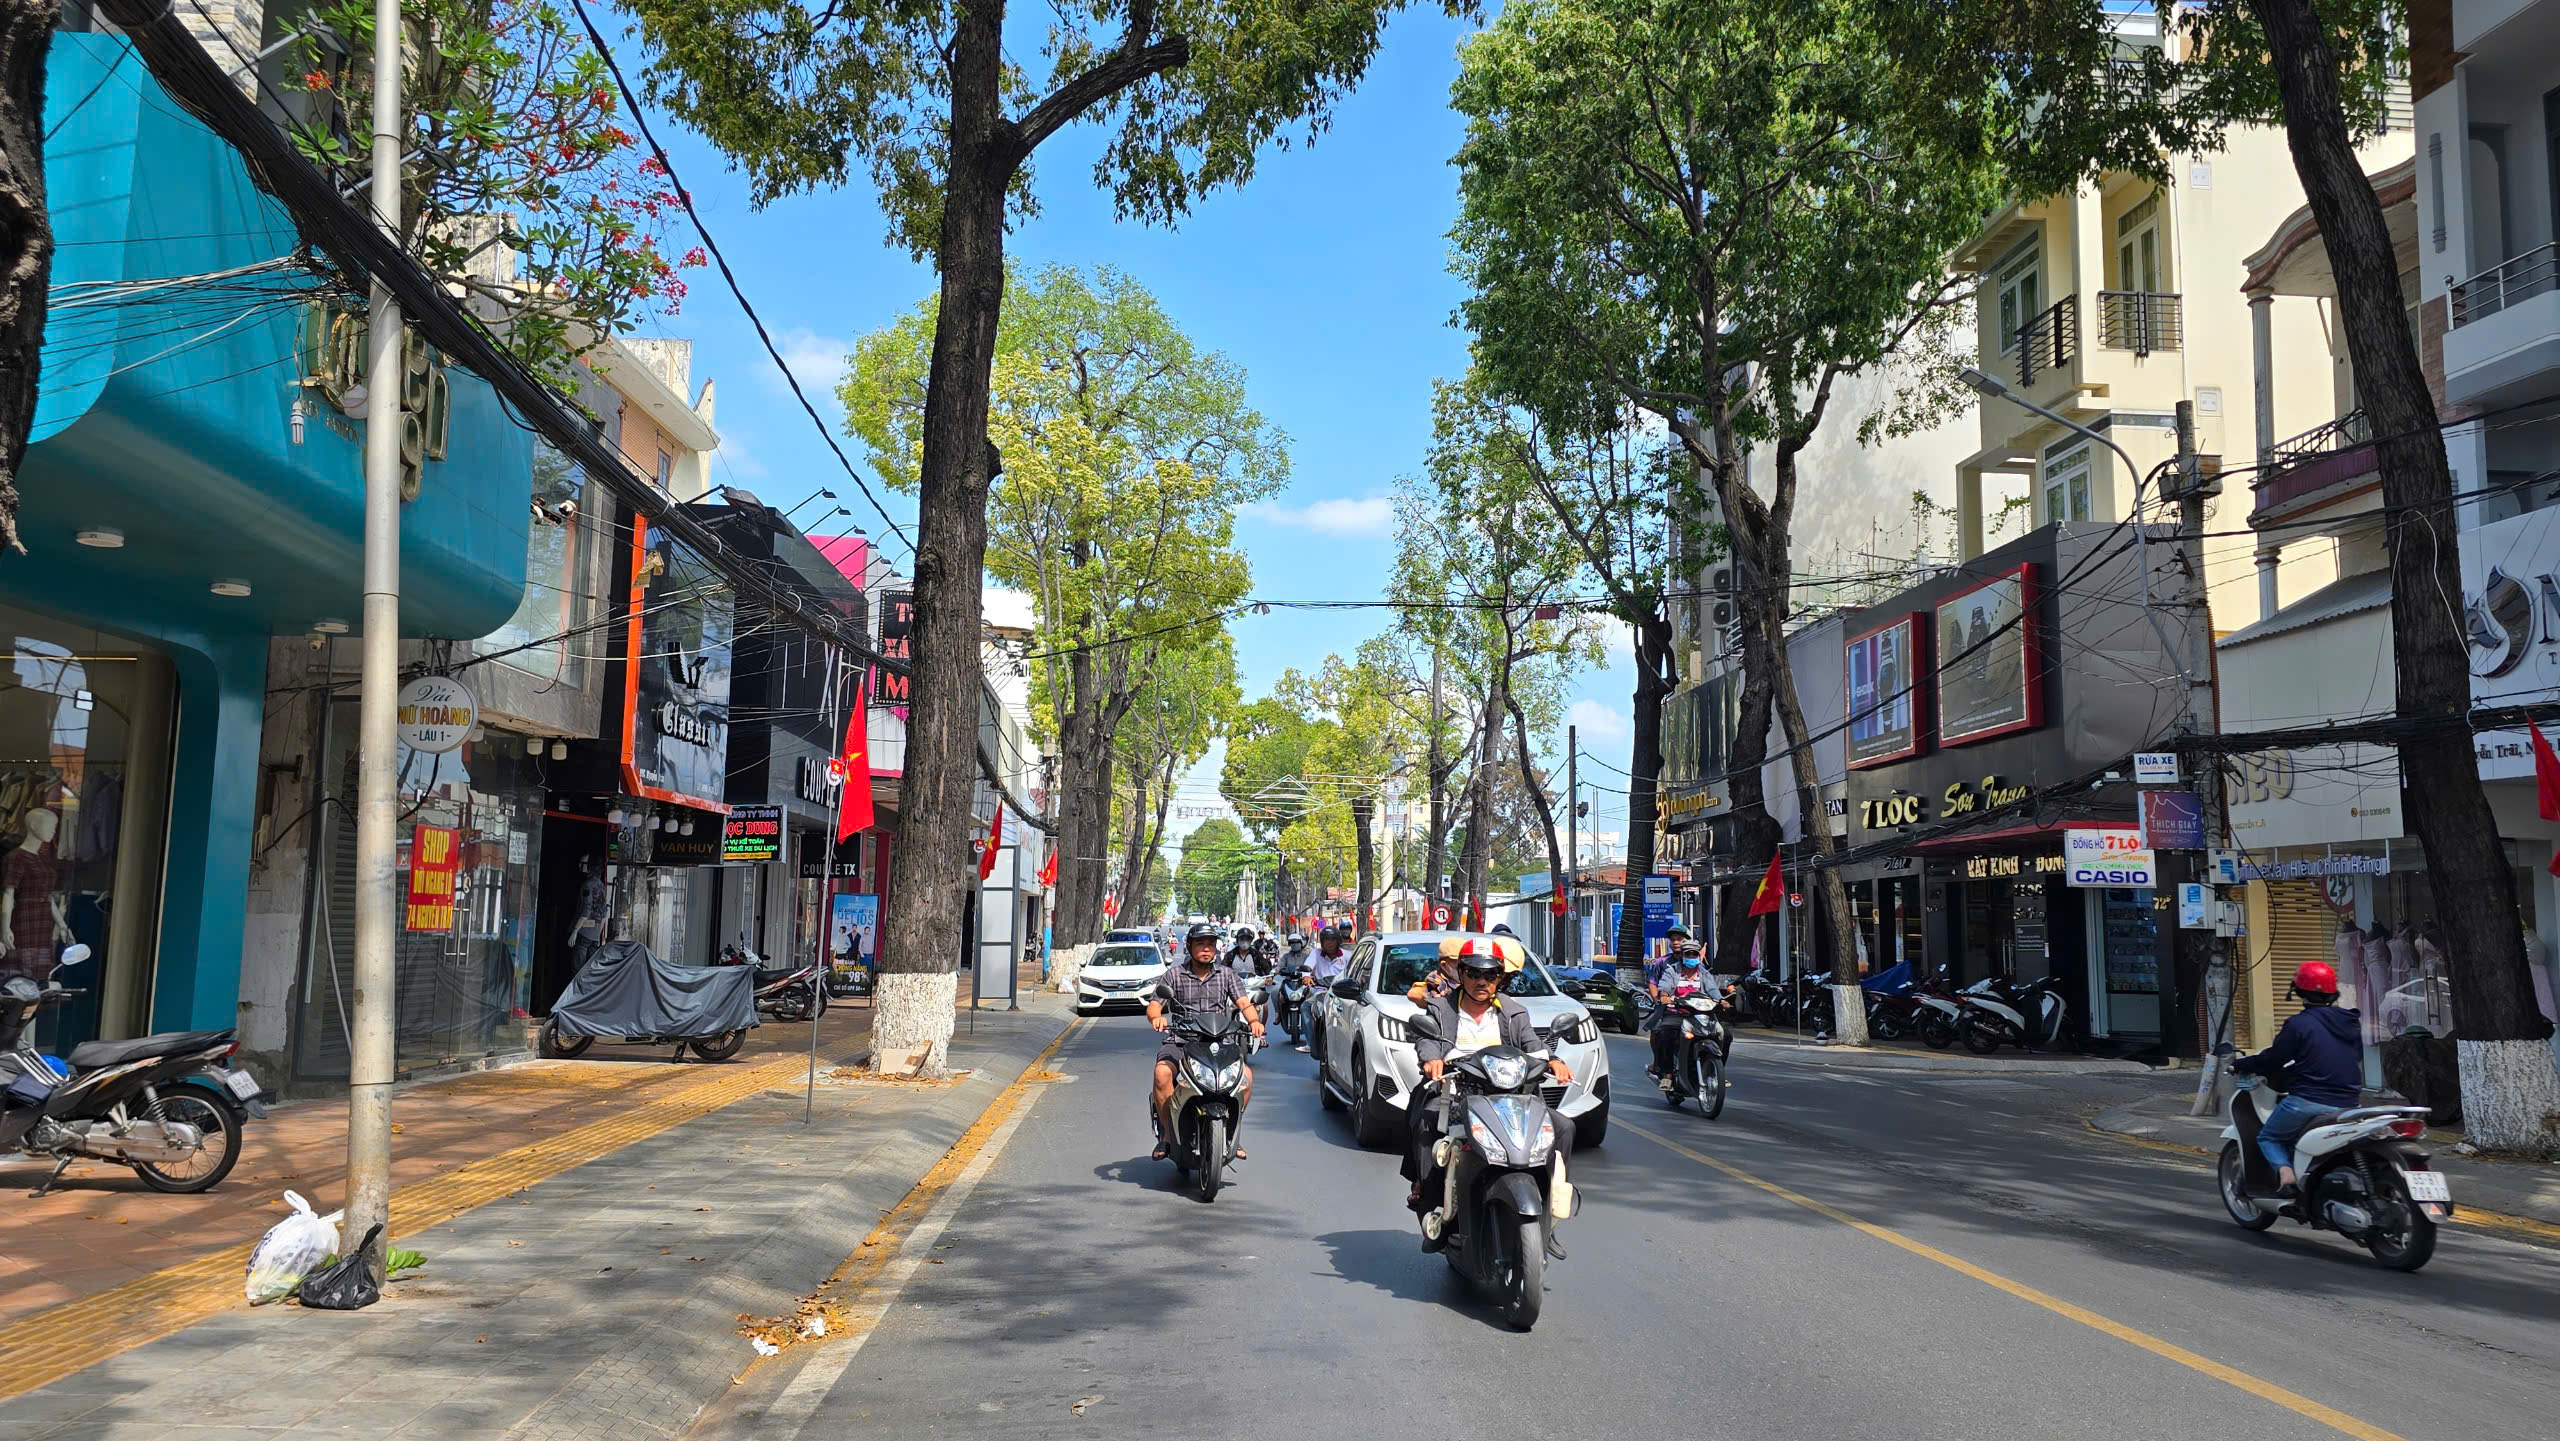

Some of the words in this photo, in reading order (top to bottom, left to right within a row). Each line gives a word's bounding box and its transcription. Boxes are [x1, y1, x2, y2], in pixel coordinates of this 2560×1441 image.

[398, 704, 418, 725] NỮ
[420, 704, 471, 726] HOÀNG
[2138, 754, 2159, 765] RỬA
[2161, 756, 2174, 765] XE
[423, 829, 450, 864] SHOP
[2117, 834, 2142, 852] LỘ
[843, 863, 856, 875] TX
[2075, 870, 2149, 884] CASIO
